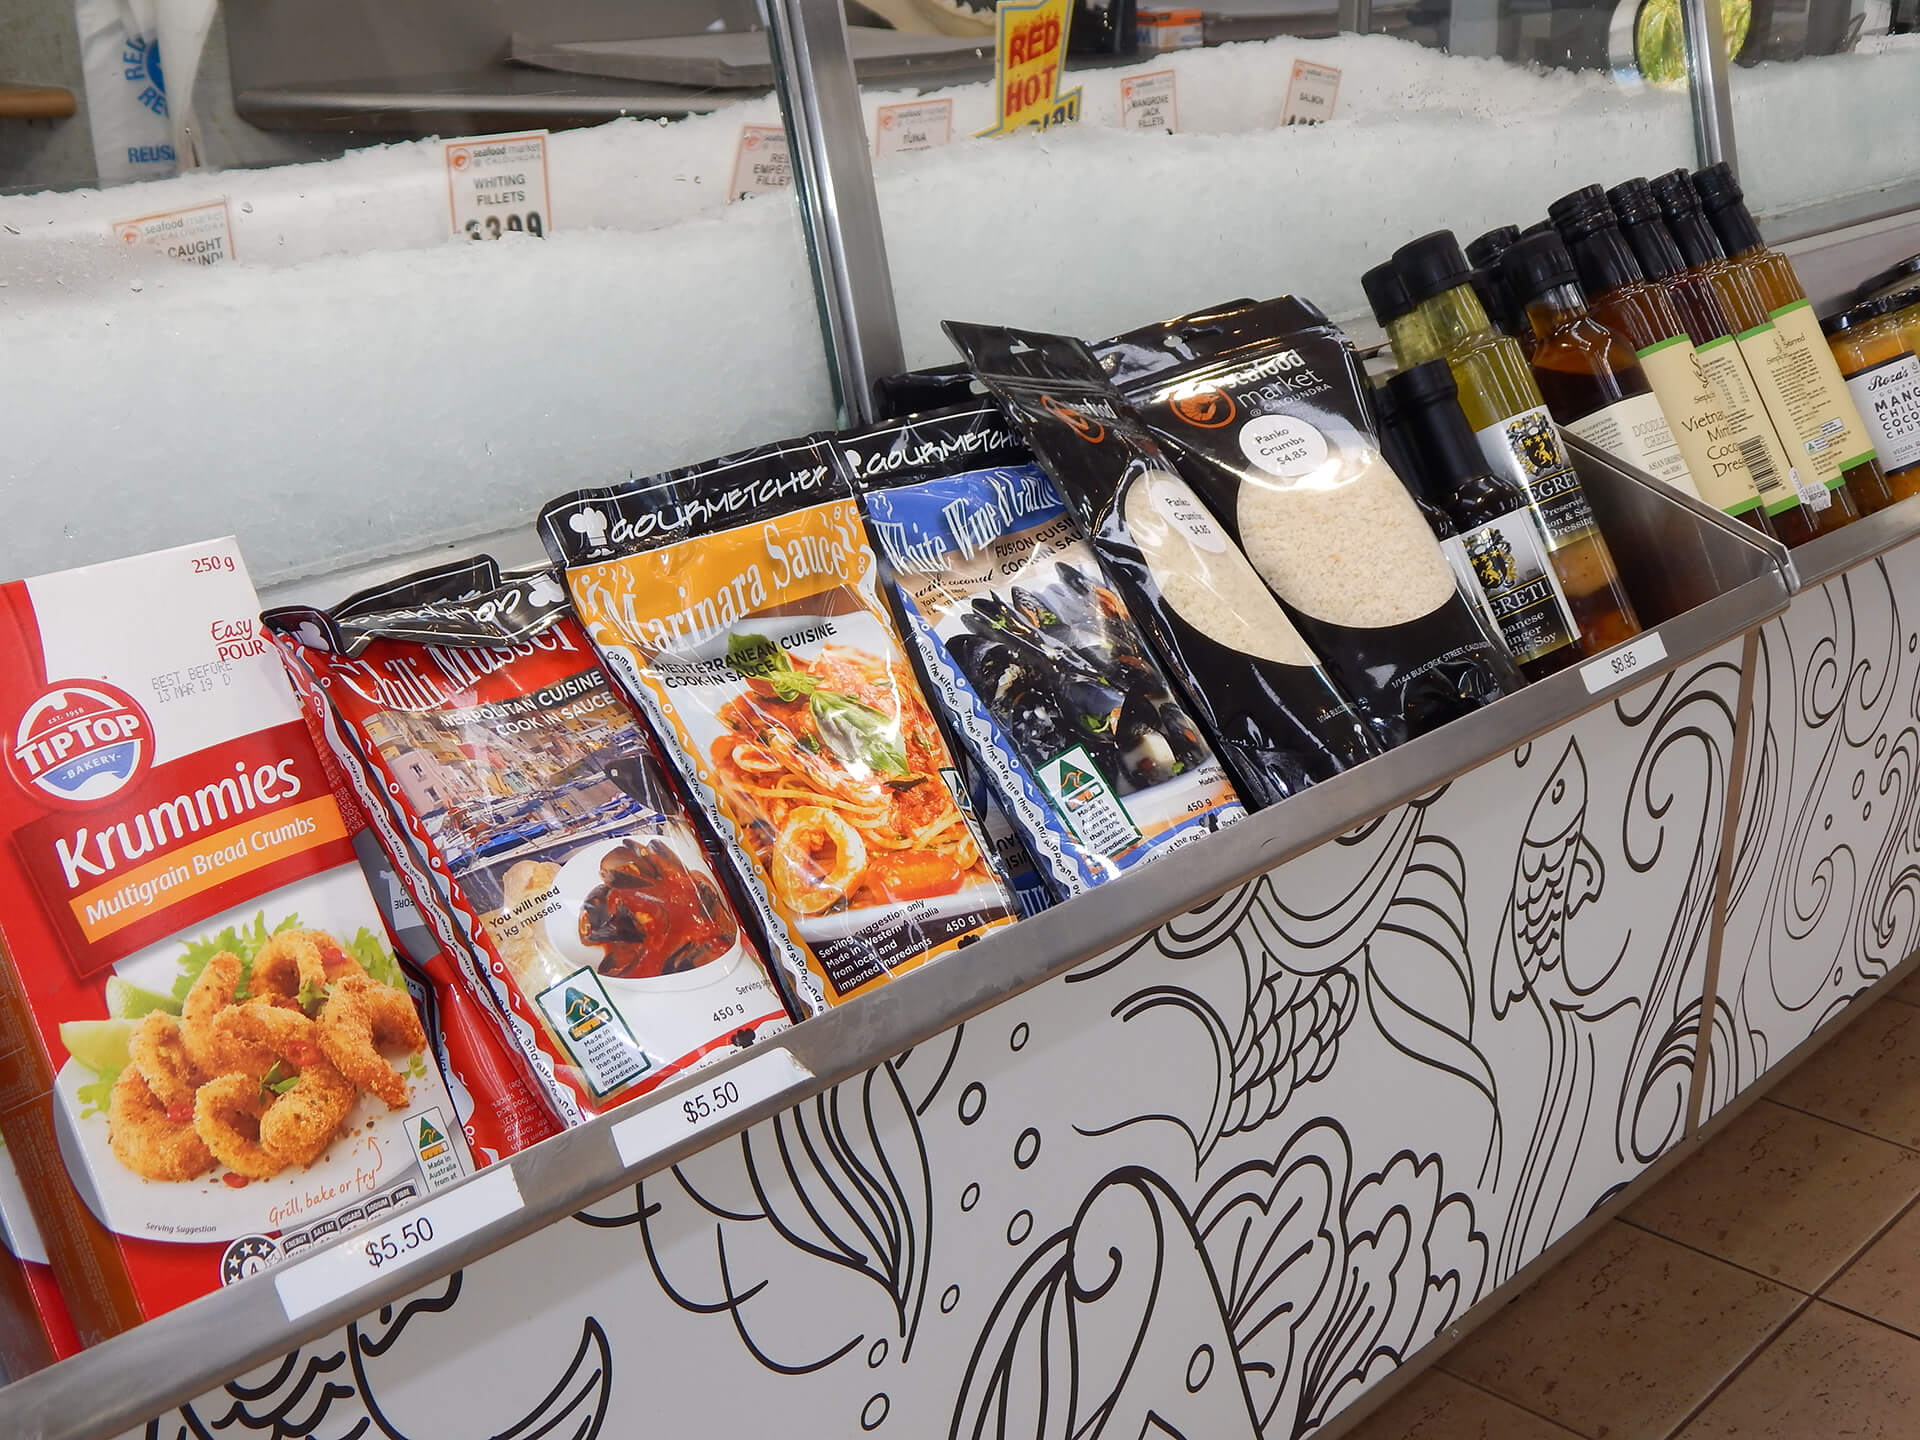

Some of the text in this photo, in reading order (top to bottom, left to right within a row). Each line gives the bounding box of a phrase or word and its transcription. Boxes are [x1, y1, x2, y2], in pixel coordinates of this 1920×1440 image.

[1008, 18, 1060, 69] RED
[1006, 64, 1057, 117] HOT
[473, 174, 526, 189] WHITING
[477, 191, 526, 206] FILLETS
[168, 237, 222, 258] CAUGHT
[1237, 367, 1323, 408] market
[1868, 366, 1909, 391] Roza's
[1875, 386, 1920, 412] MANG
[1681, 411, 1724, 432] Vietna
[1883, 411, 1919, 430] COCO
[1255, 427, 1289, 444] Panko
[1260, 437, 1305, 456] Crumbs
[1277, 448, 1307, 465] $4.85
[610, 465, 828, 543] GOURMETCHEF
[872, 519, 952, 576] White
[942, 498, 1001, 561] Wine
[995, 537, 1034, 558] FUSION
[1056, 530, 1084, 550] SAU
[192, 556, 235, 574] 250 g
[602, 563, 768, 652] Marinara
[763, 523, 852, 592] Sauce
[948, 568, 993, 586] coconut
[211, 619, 253, 642] Easy
[1508, 625, 1541, 645] inger
[1534, 632, 1556, 647] Soy
[217, 639, 266, 661] POUR
[655, 622, 837, 675] MEDITERRANEAN CUISINE
[665, 659, 777, 689] COOK-IN SAUCE
[1611, 651, 1637, 674] $8.95
[151, 659, 233, 691] BEST BEFORE
[329, 657, 448, 712] Chilli
[157, 689, 171, 703] 13
[174, 682, 196, 700] MAR
[200, 678, 213, 693] 19
[440, 670, 605, 728] NEAPOLITAN CUISINE
[495, 716, 541, 737] COOK
[565, 691, 615, 720] SAUCE
[14, 713, 140, 776] TIPTOP
[919, 643, 934, 662] into
[930, 662, 941, 678] the
[986, 744, 998, 763] first
[997, 760, 1010, 780] rate
[1006, 781, 1020, 797] fire
[1034, 821, 1047, 840] and
[607, 651, 632, 672] Come
[732, 843, 744, 862] first
[743, 862, 755, 883] rate
[752, 886, 765, 902] fire
[762, 904, 778, 933] there,
[779, 932, 793, 951] and
[1186, 798, 1212, 813] 450 g
[55, 758, 301, 888] Krummies
[1089, 828, 1105, 841] than
[1094, 827, 1126, 849] Australian
[1098, 833, 1133, 855] ngredients
[1174, 836, 1187, 848] the
[85, 816, 316, 925] Multigrain Bread Crumbs
[489, 886, 561, 929] You will need
[504, 901, 562, 939] kg mussels
[819, 900, 925, 959] Serving suggestion only
[945, 915, 976, 934] 450 g
[826, 906, 939, 969] Made in Western Australia
[832, 939, 898, 980] from local and
[838, 963, 881, 992] imported
[713, 1003, 745, 1022] 450 g
[583, 1033, 602, 1047] Made
[587, 1035, 617, 1056] Australia
[589, 1041, 624, 1064] from more
[595, 1058, 610, 1071] than
[600, 1056, 633, 1078] Australian
[602, 1063, 640, 1087] ingredients
[683, 1081, 739, 1124] $5.50
[427, 1159, 443, 1170] Made
[429, 1163, 456, 1179] Australia
[434, 1173, 457, 1187] from at
[269, 1168, 376, 1226] Grill, bake or fry
[145, 1222, 217, 1235] Serving Suggestion
[285, 1233, 308, 1249] ENERGY
[365, 1217, 433, 1267] $5.50
